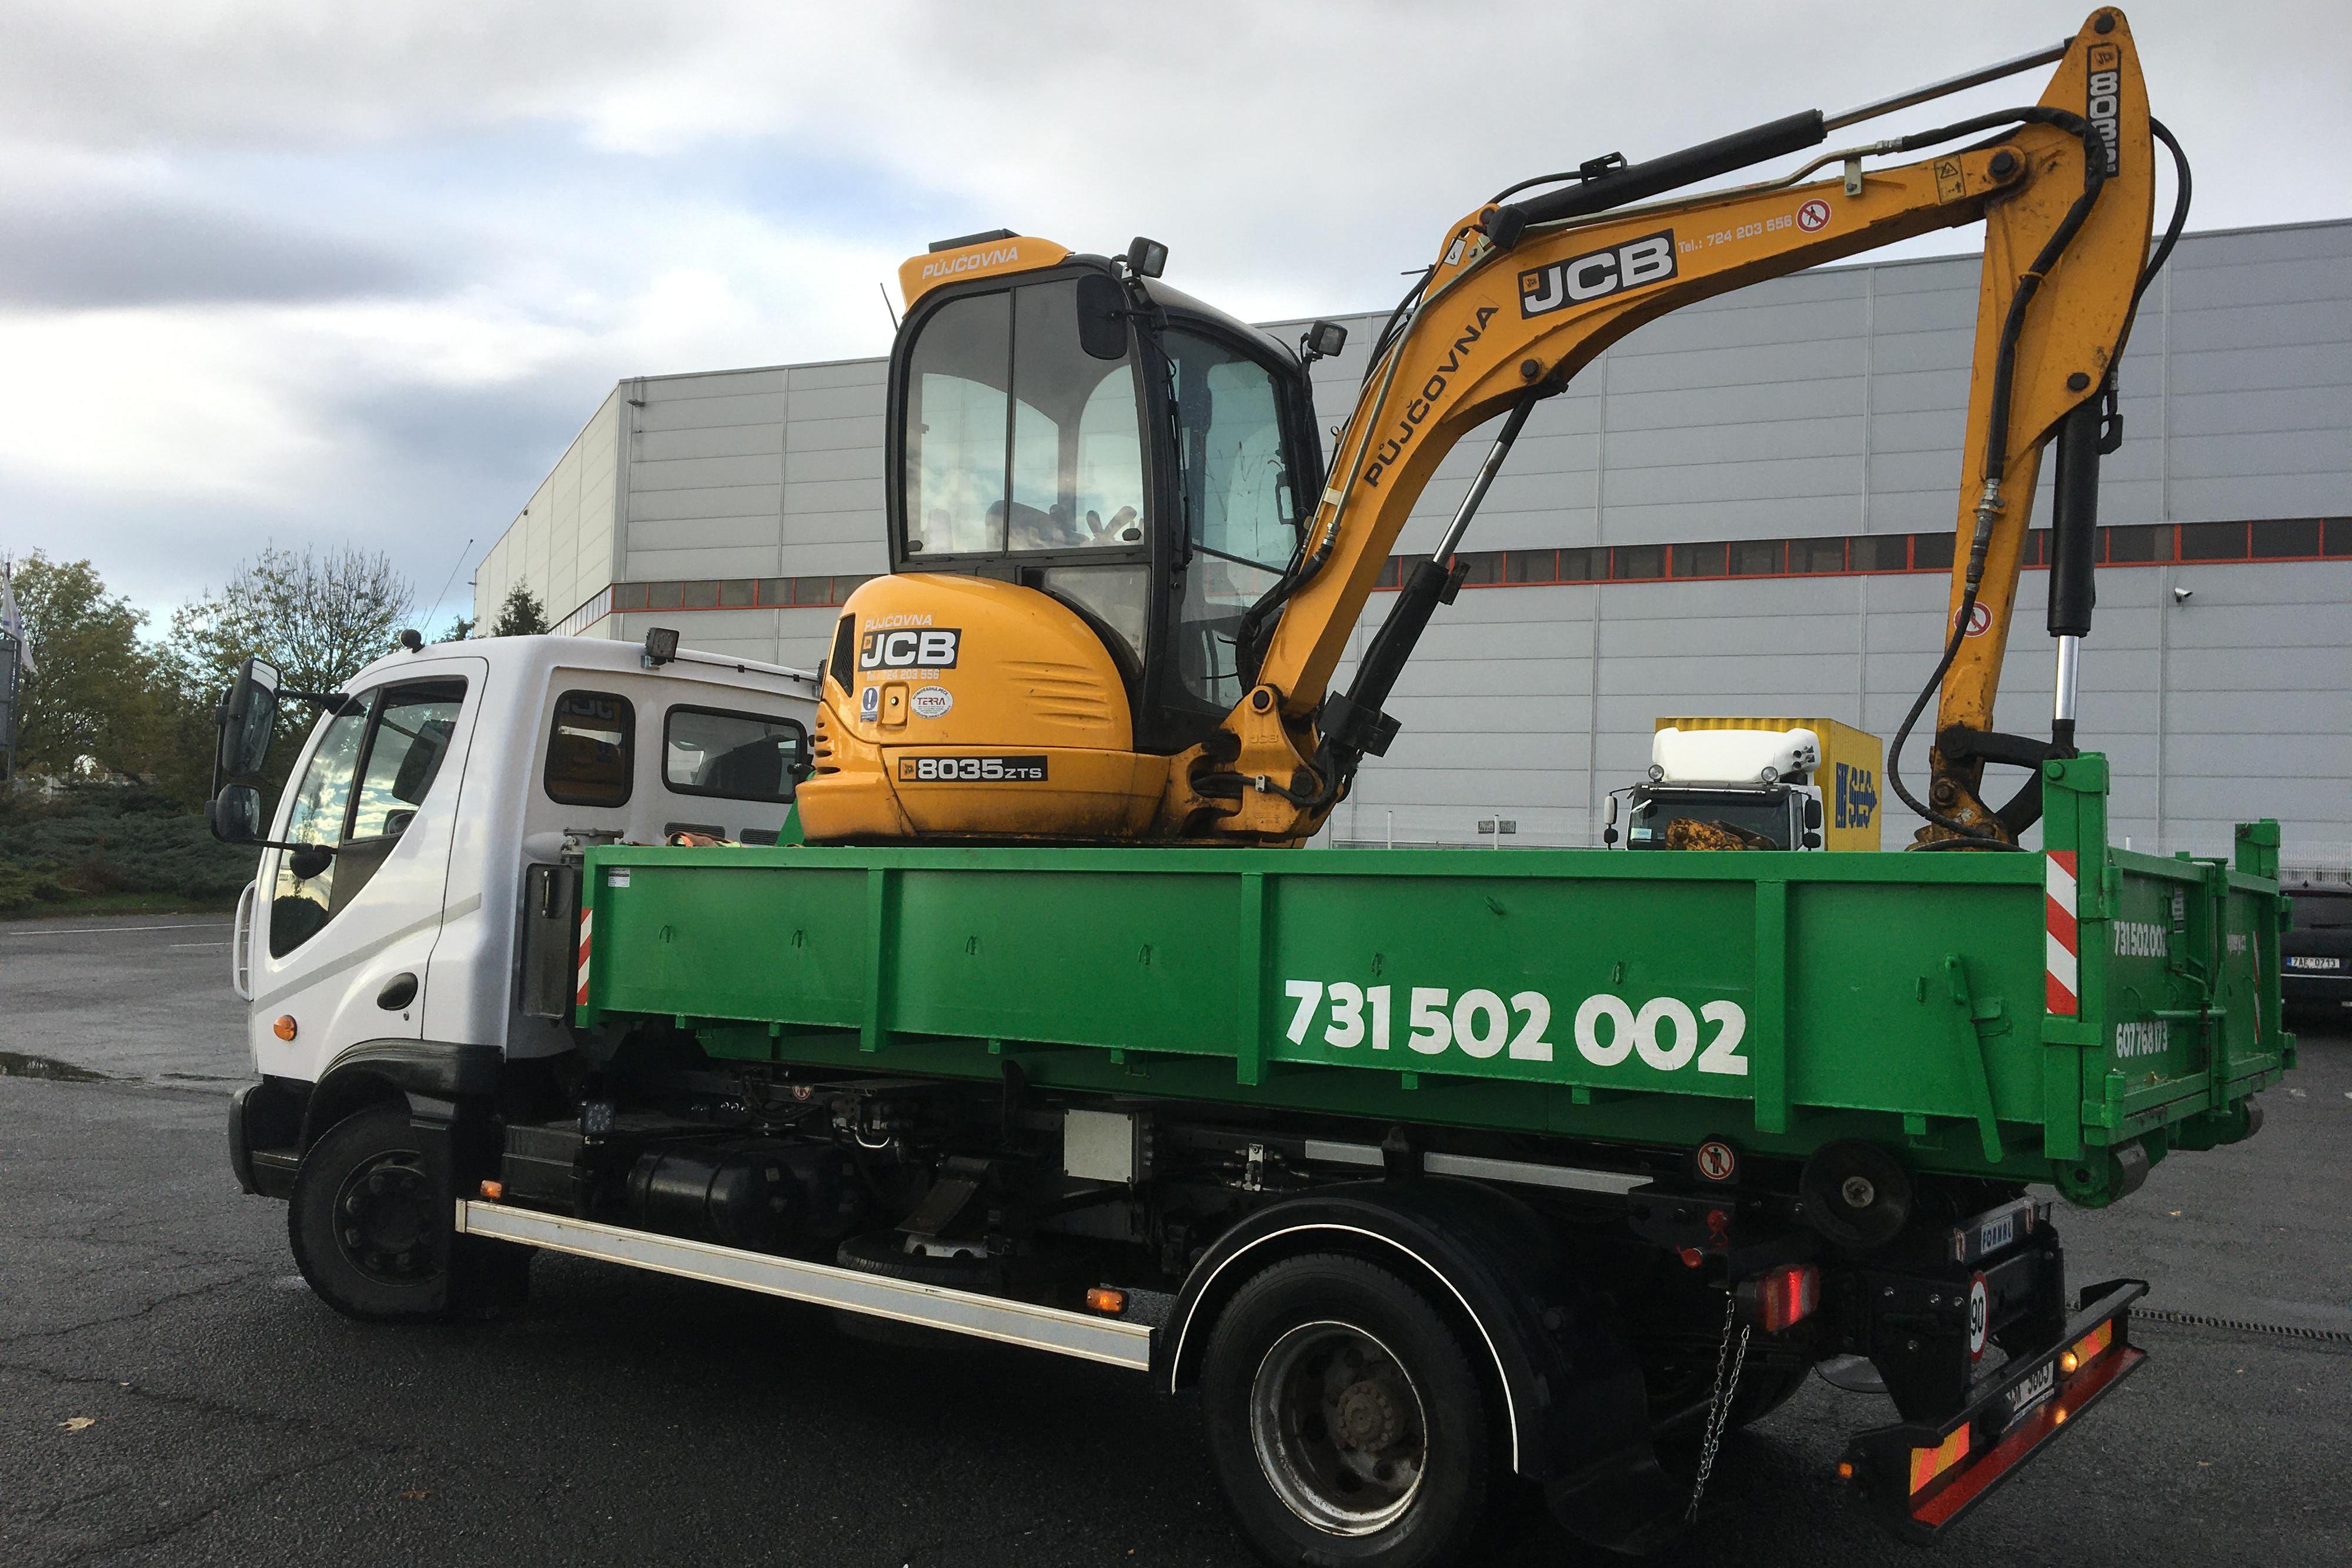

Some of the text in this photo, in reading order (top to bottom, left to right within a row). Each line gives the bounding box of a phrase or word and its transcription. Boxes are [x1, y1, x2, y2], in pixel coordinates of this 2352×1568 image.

[1678, 214, 1793, 253] Tel.: 724 203 556
[922, 246, 1018, 279] PŮJČOVNA
[1524, 237, 1673, 313] JCB
[1363, 306, 1500, 487] PŮJČOVNA
[861, 631, 957, 668] JCB
[917, 697, 946, 706] TERRA
[1285, 979, 1748, 1075] 731 502 002
[1971, 1296, 1984, 1336] 90
